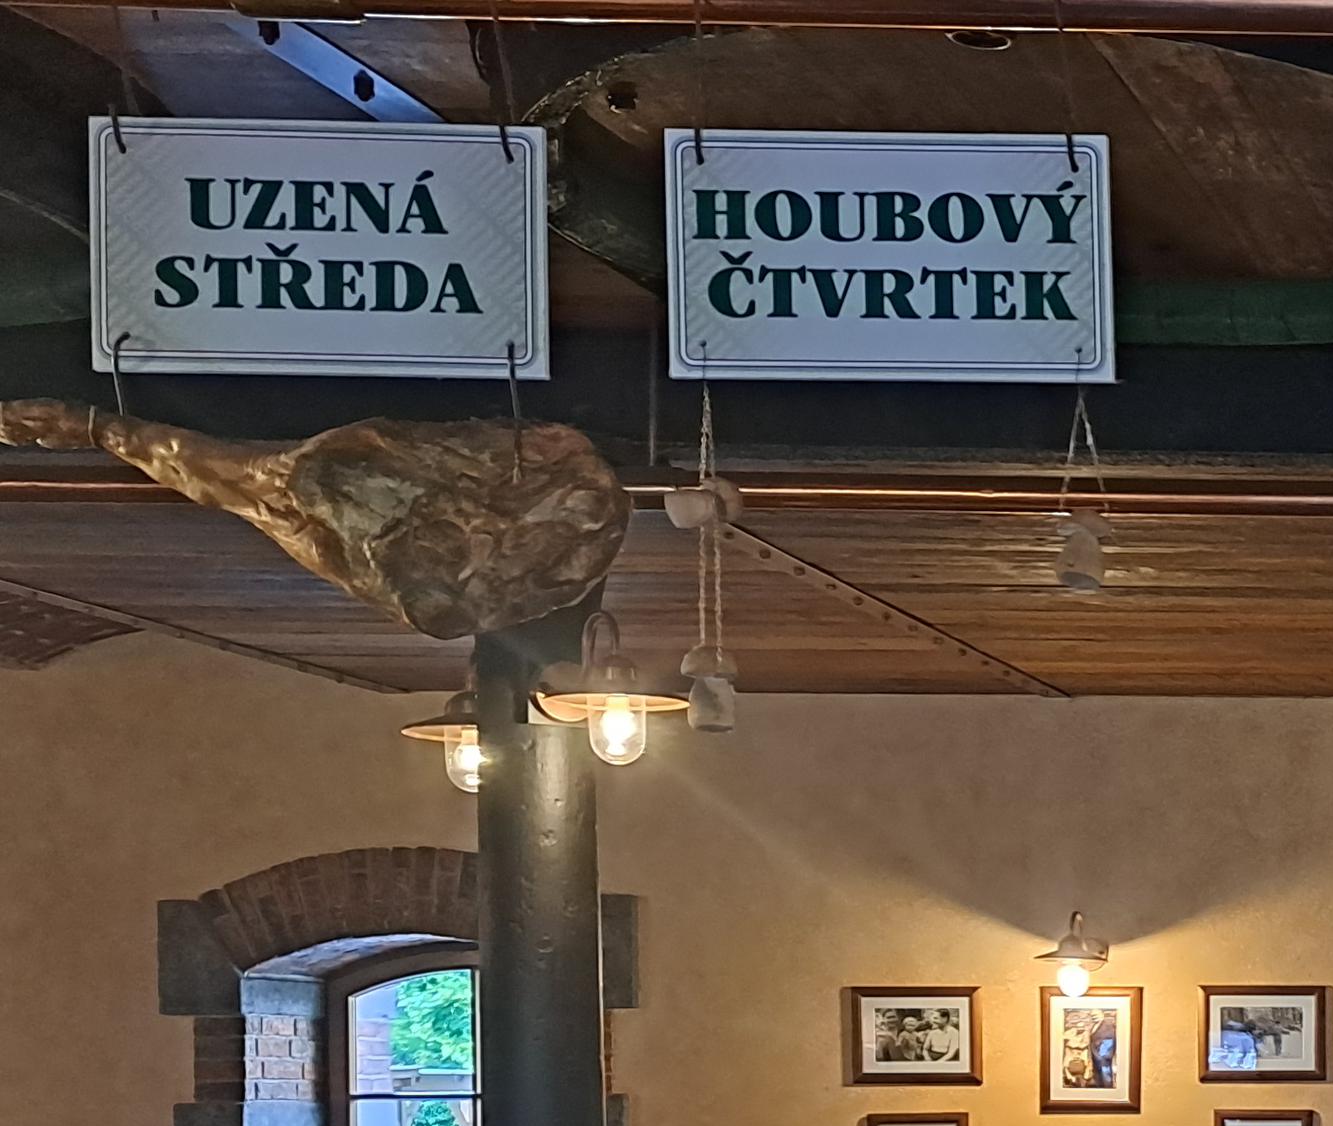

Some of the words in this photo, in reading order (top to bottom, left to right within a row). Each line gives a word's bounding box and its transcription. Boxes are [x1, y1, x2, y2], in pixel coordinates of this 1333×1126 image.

[186, 169, 449, 235] UZENÁ
[692, 181, 1087, 246] HOUBOVÝ
[153, 243, 484, 315] STŘEDA
[706, 251, 1078, 321] ČTVRTEK
